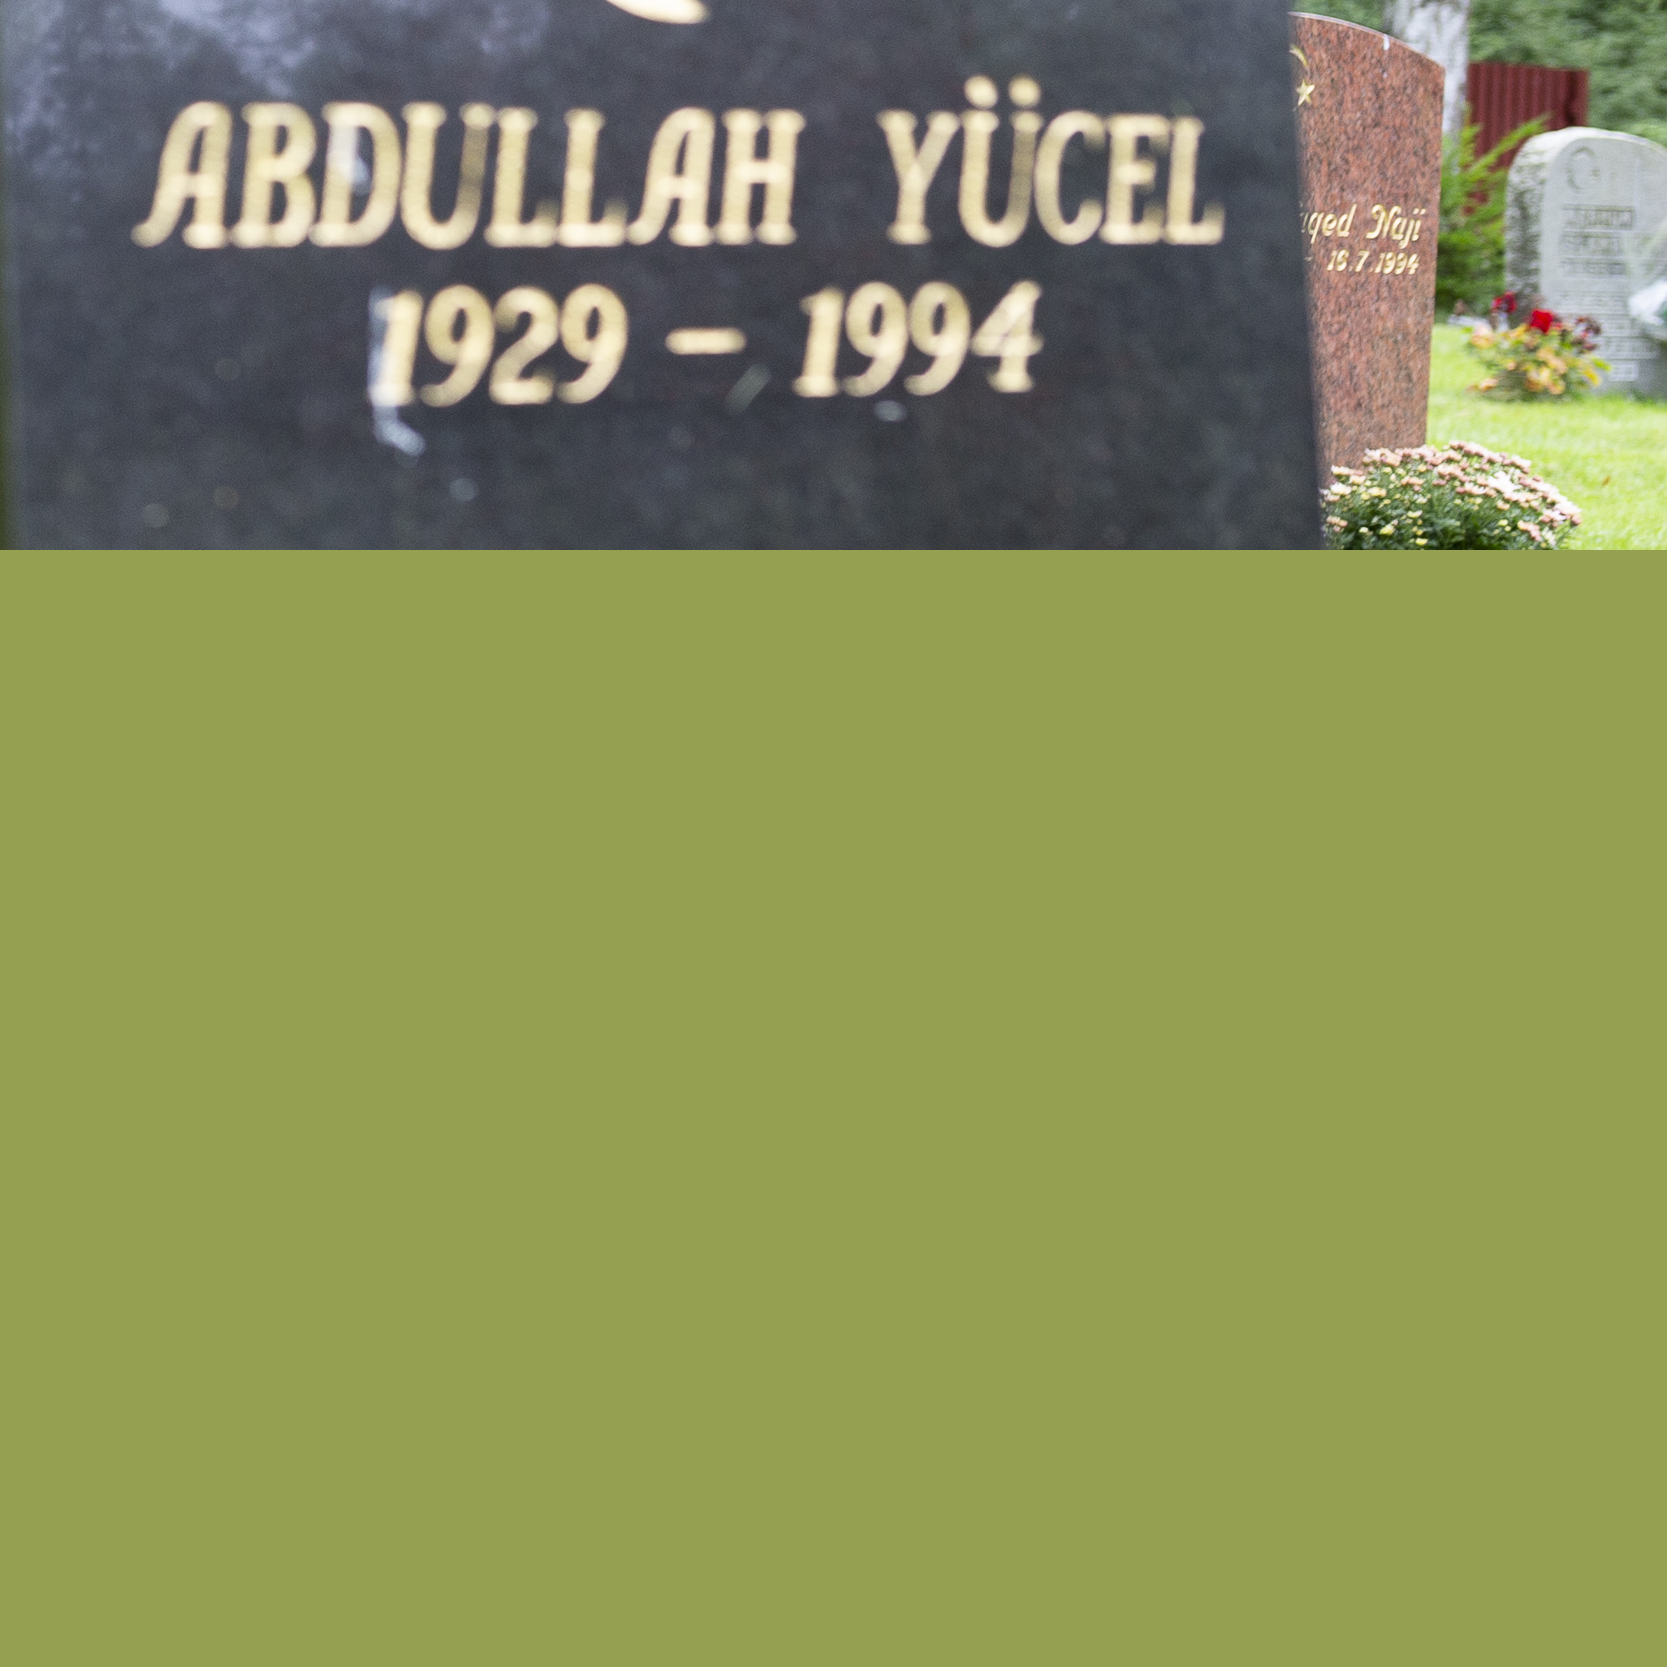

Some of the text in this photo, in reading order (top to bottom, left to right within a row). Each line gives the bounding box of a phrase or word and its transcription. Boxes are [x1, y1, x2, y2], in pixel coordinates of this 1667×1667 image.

[131, 75, 1226, 250] ABDULLAH YÜCEL
[1365, 204, 1427, 249] Naji
[369, 283, 628, 407] 1929
[792, 279, 1044, 397] 1994
